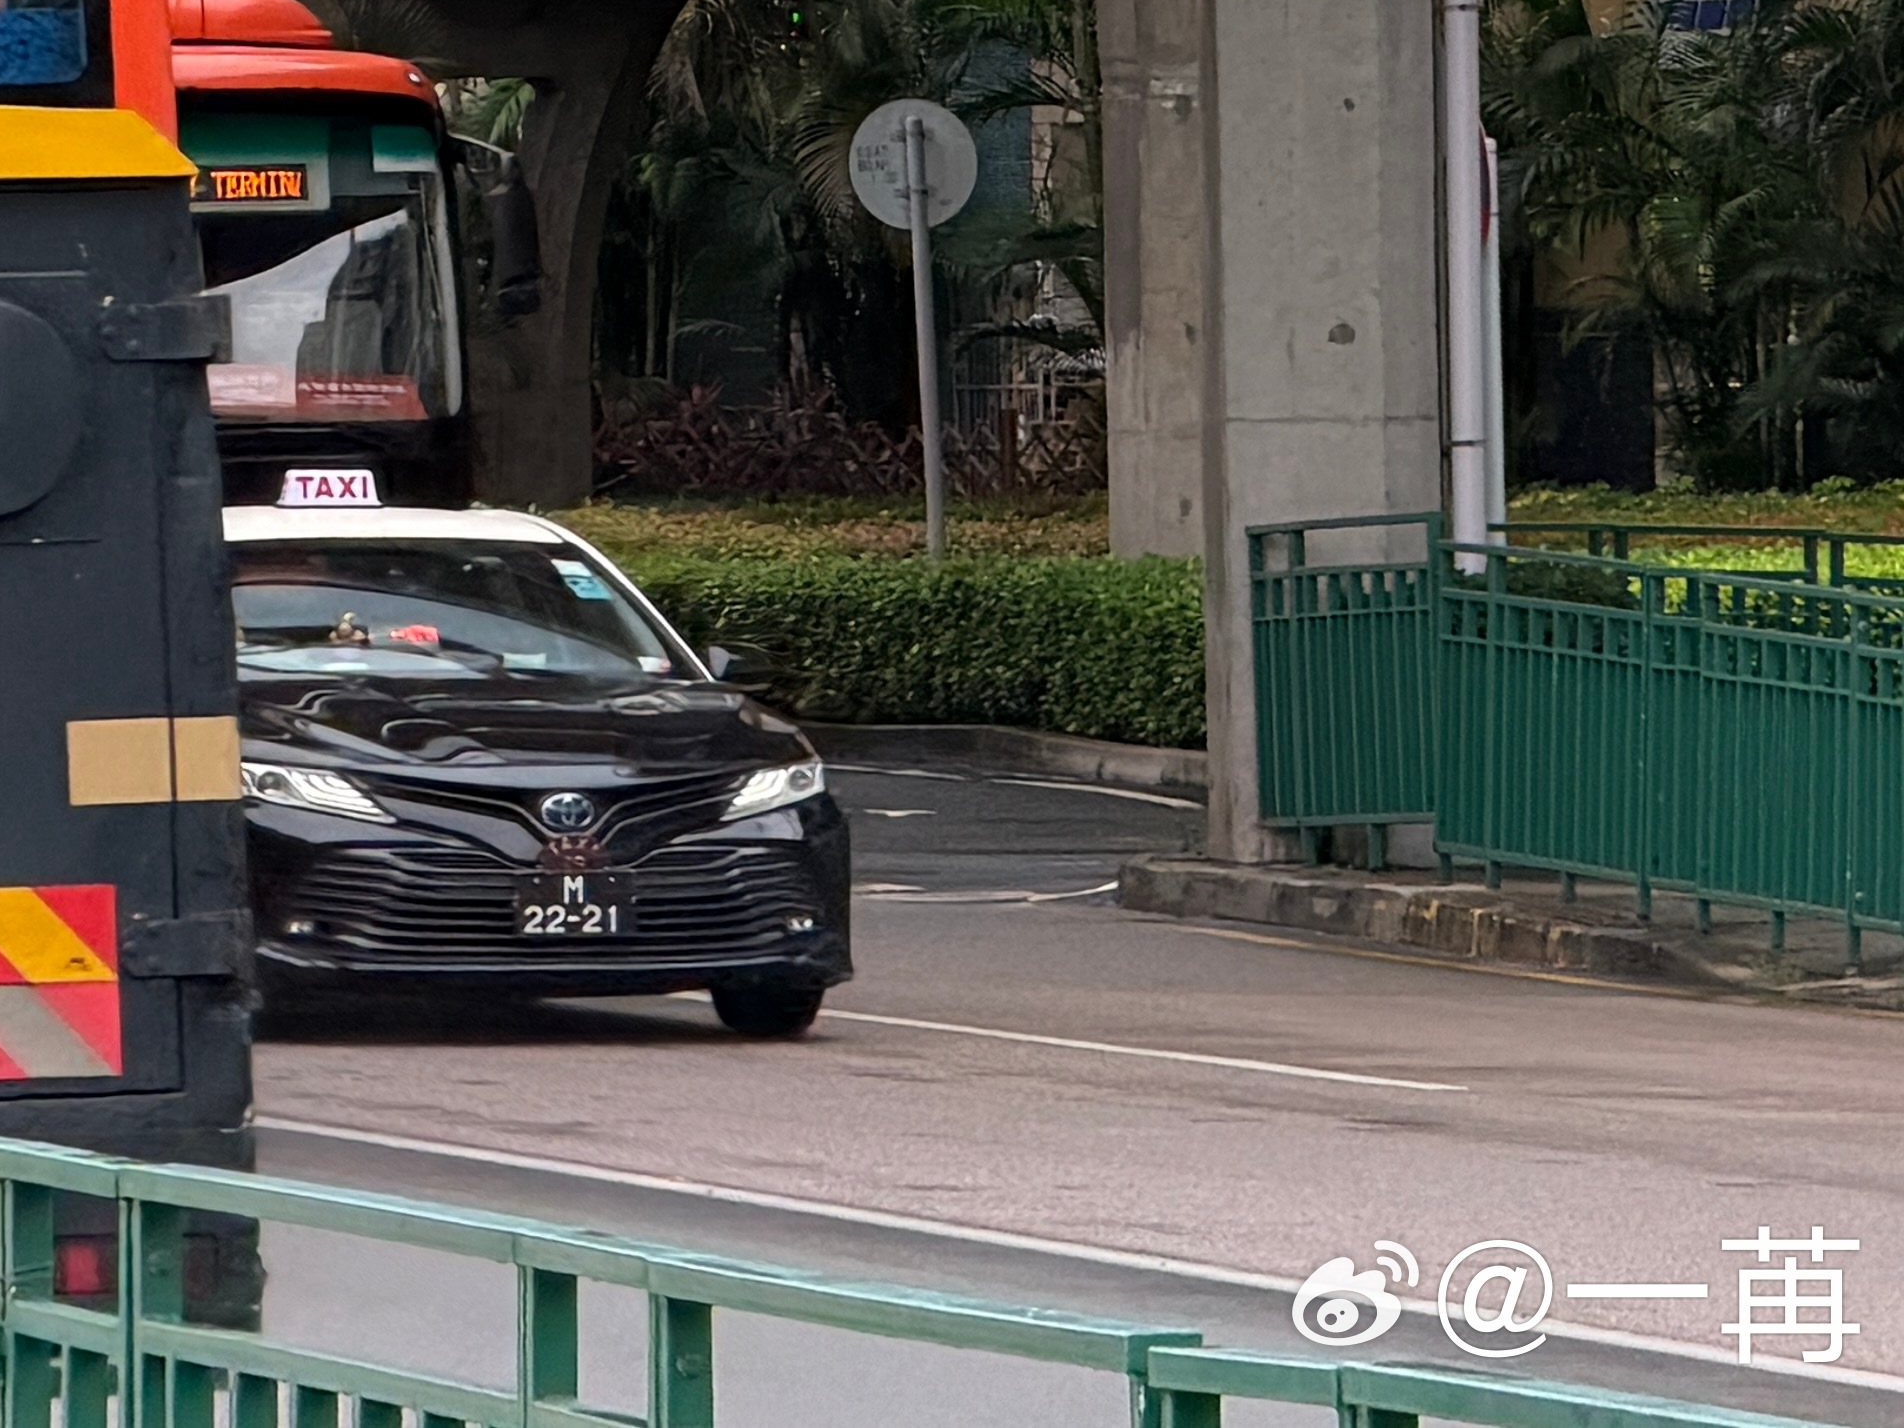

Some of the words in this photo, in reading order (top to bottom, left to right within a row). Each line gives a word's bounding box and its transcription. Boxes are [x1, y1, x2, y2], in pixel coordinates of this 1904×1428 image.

[294, 475, 369, 499] TAXI
[563, 875, 584, 905] M
[522, 904, 618, 934] 22-21
